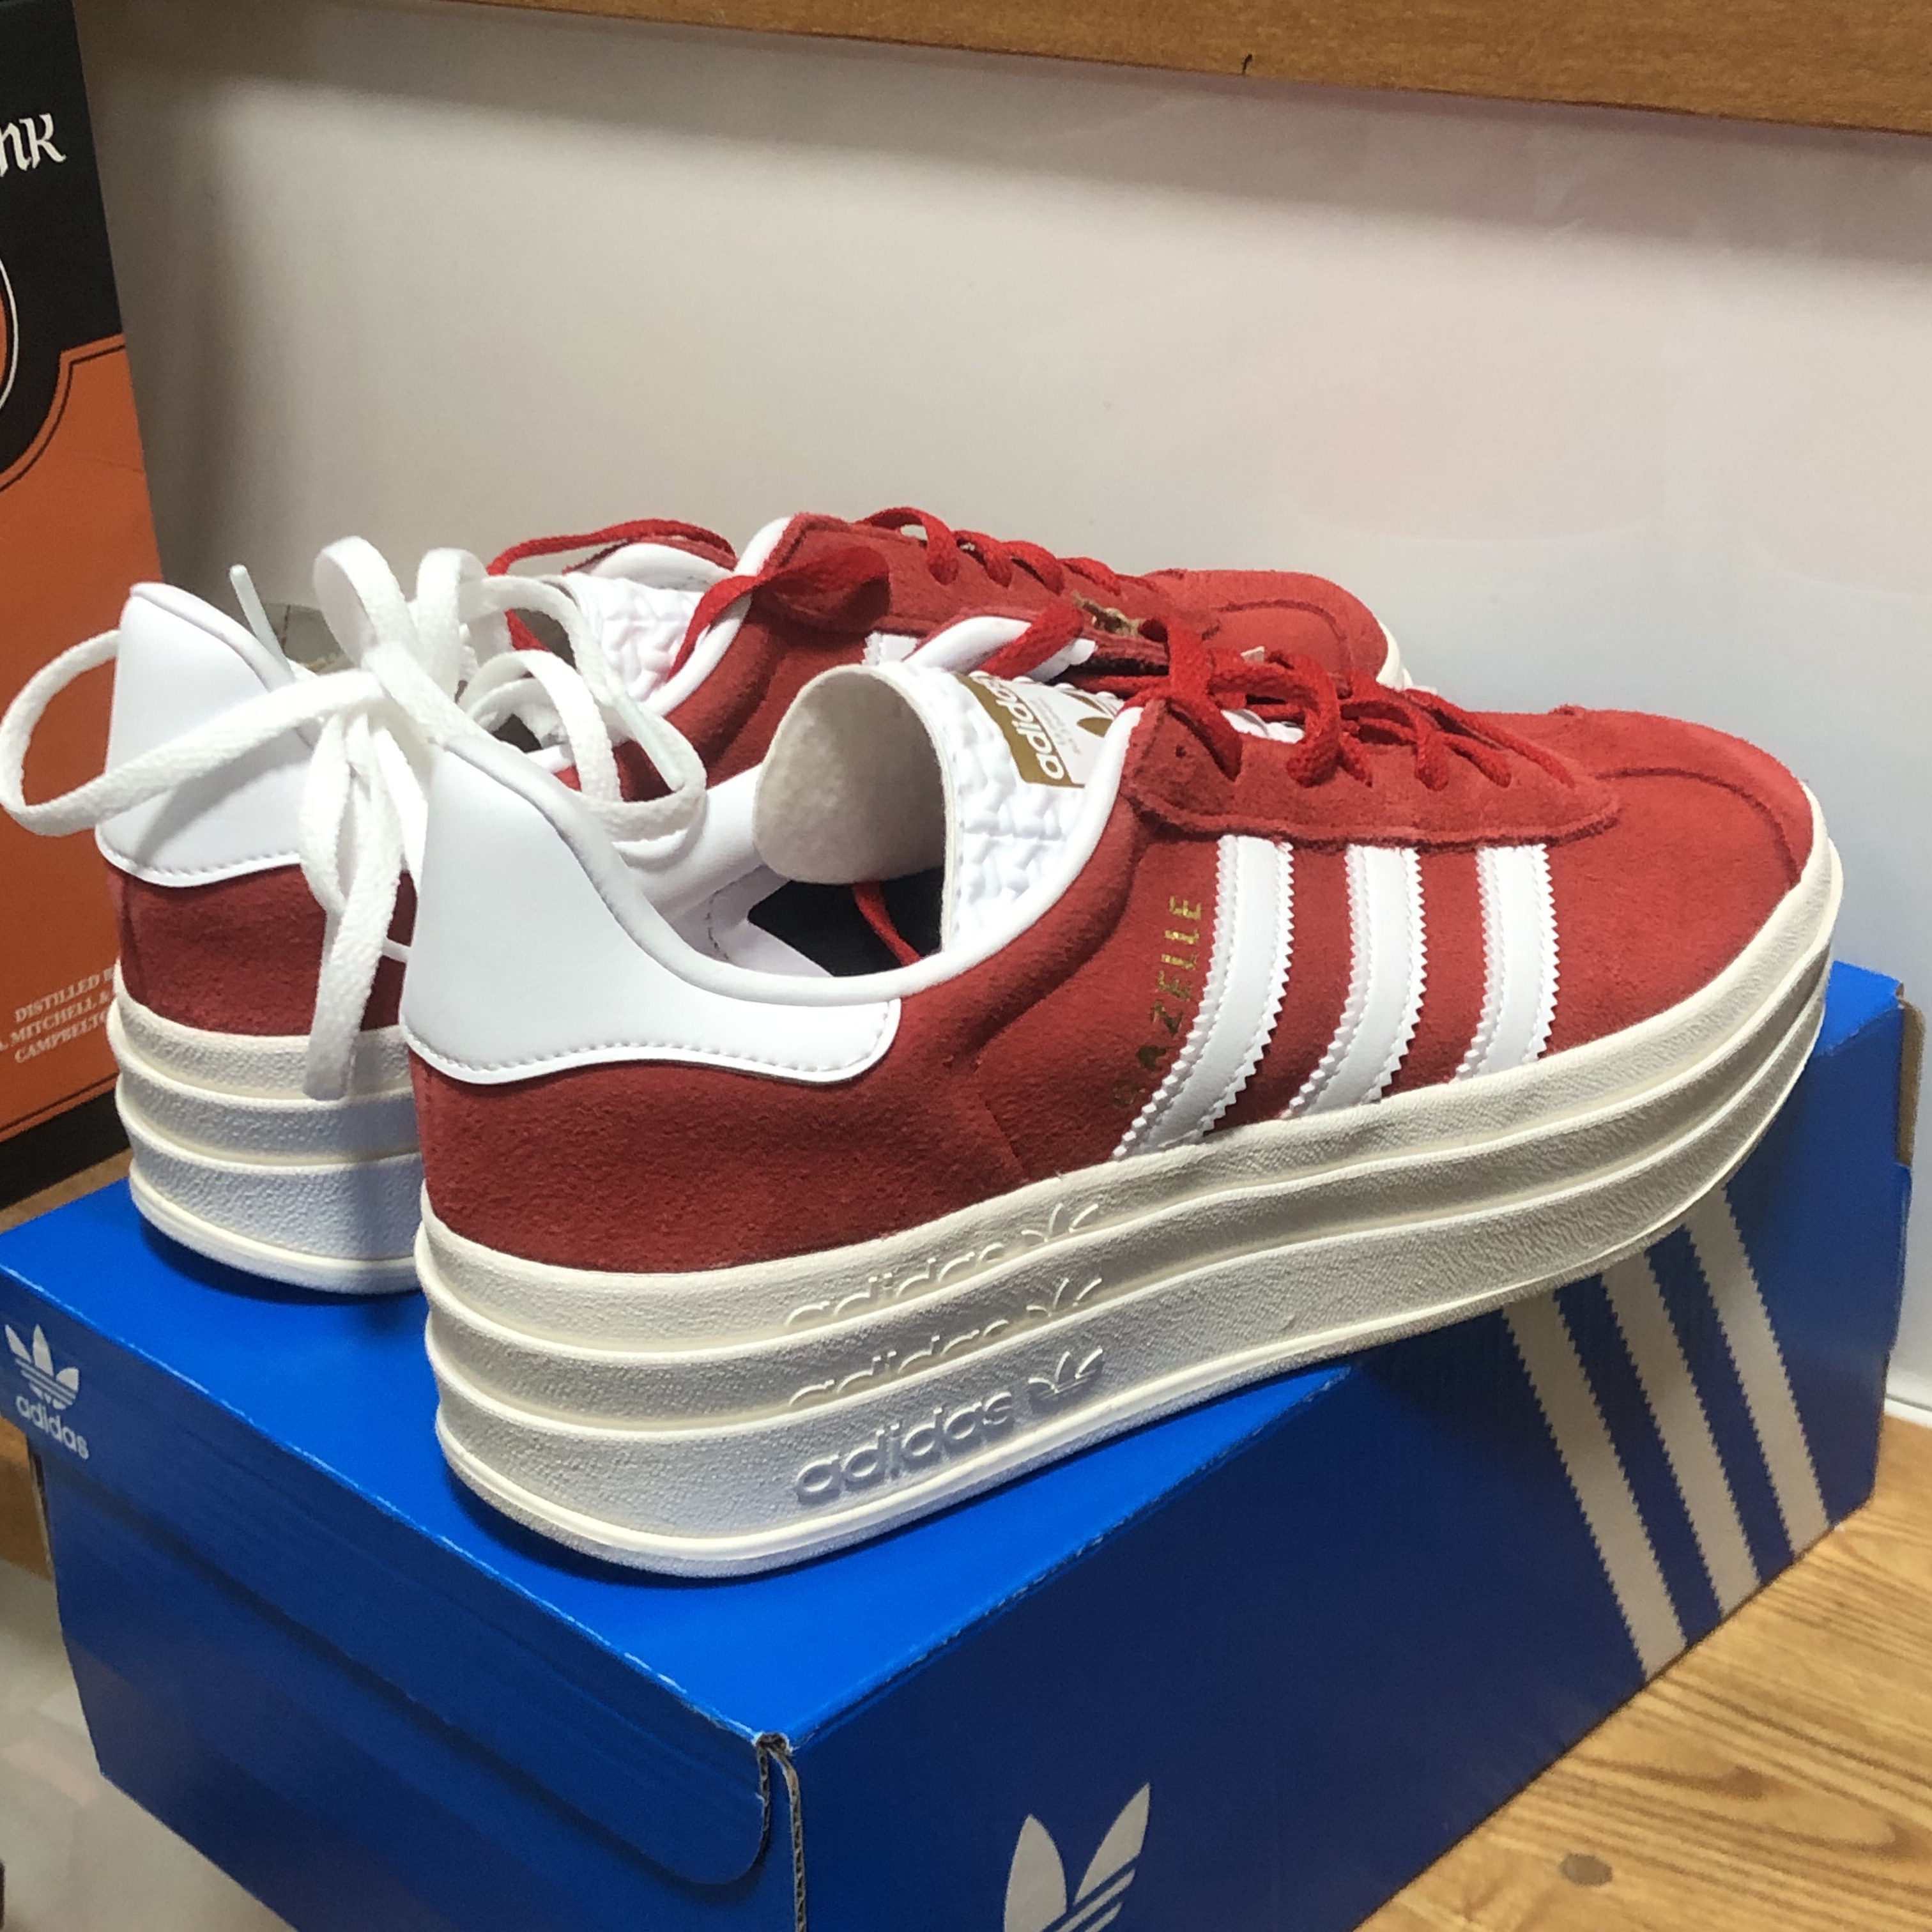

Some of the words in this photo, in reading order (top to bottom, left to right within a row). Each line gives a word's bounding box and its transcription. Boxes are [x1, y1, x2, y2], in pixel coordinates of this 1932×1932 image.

[15, 974, 100, 1023] DISTILLED
[16, 1395, 89, 1460] adidas
[795, 1392, 1014, 1503] adidas
